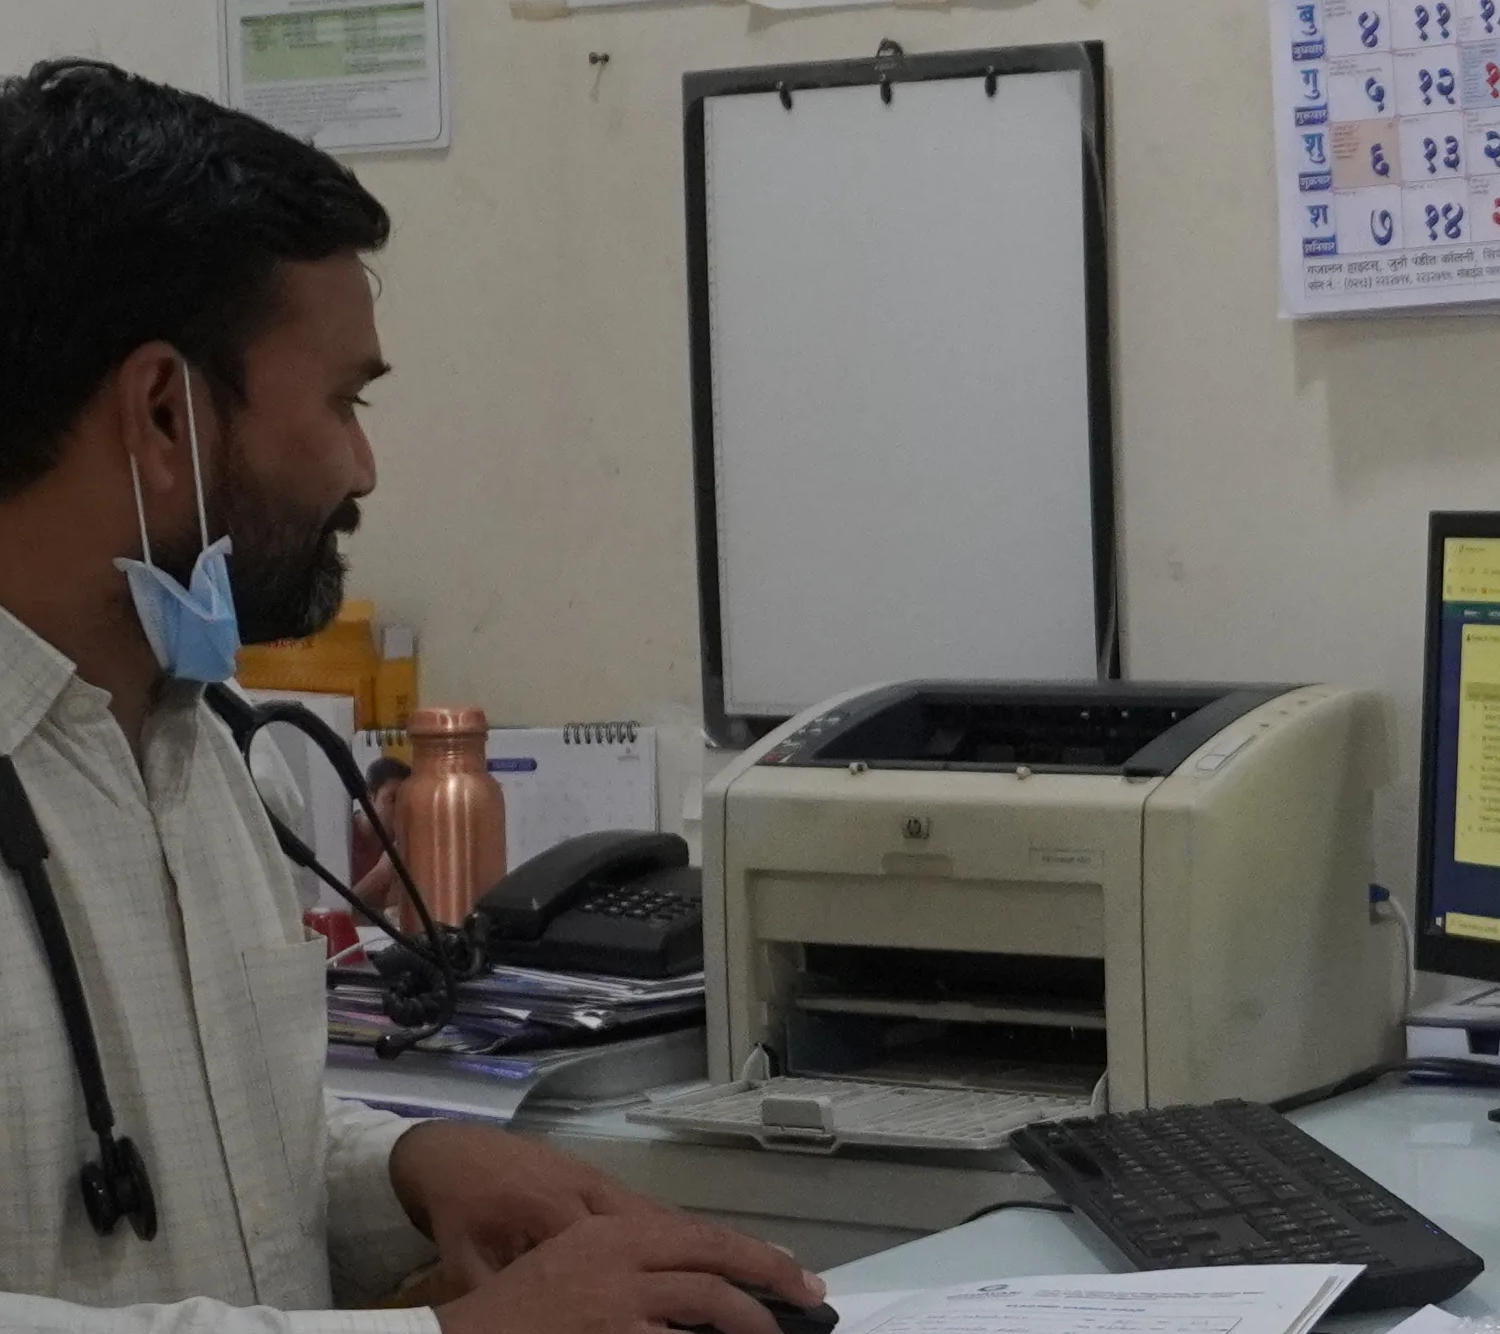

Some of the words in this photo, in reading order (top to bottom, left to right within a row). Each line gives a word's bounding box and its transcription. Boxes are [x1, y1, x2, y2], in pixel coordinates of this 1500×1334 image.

[1357, 10, 1380, 49] ४
[1414, 1, 1452, 42] ११
[1365, 76, 1385, 113] ५
[1418, 67, 1455, 106] १२
[1369, 143, 1390, 179] ६
[1423, 135, 1461, 174] १३
[1370, 209, 1394, 246] ७
[1425, 202, 1463, 241] १४
